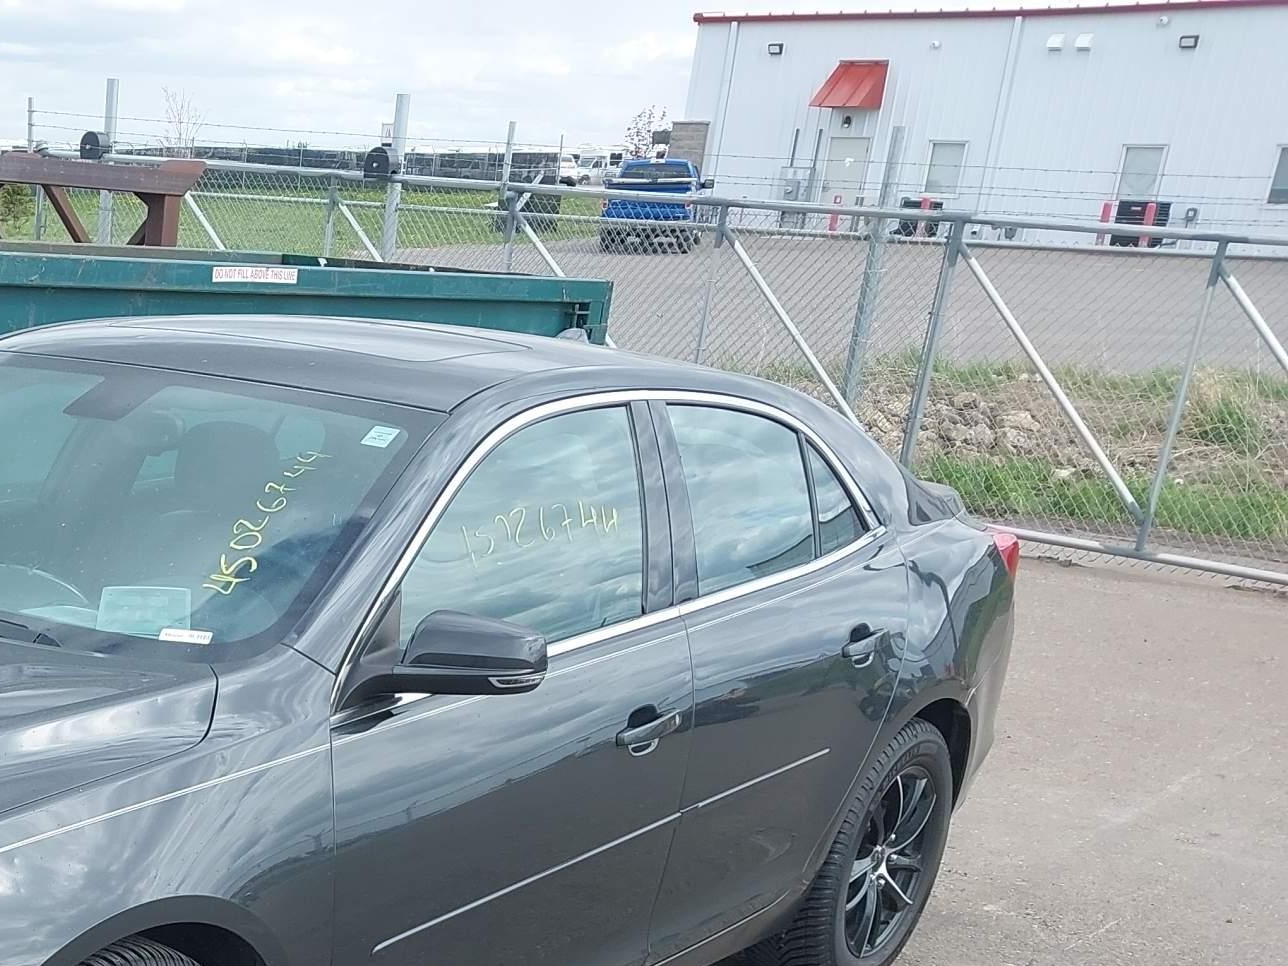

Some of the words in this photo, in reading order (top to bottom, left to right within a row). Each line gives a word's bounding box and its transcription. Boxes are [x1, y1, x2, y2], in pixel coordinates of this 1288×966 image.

[214, 268, 224, 279] DO
[224, 269, 236, 279] NOT
[237, 269, 249, 280] FILL
[250, 269, 270, 280] ABOVE
[271, 270, 283, 280] THIS
[283, 271, 295, 281] LINE
[202, 450, 333, 595] 45026744
